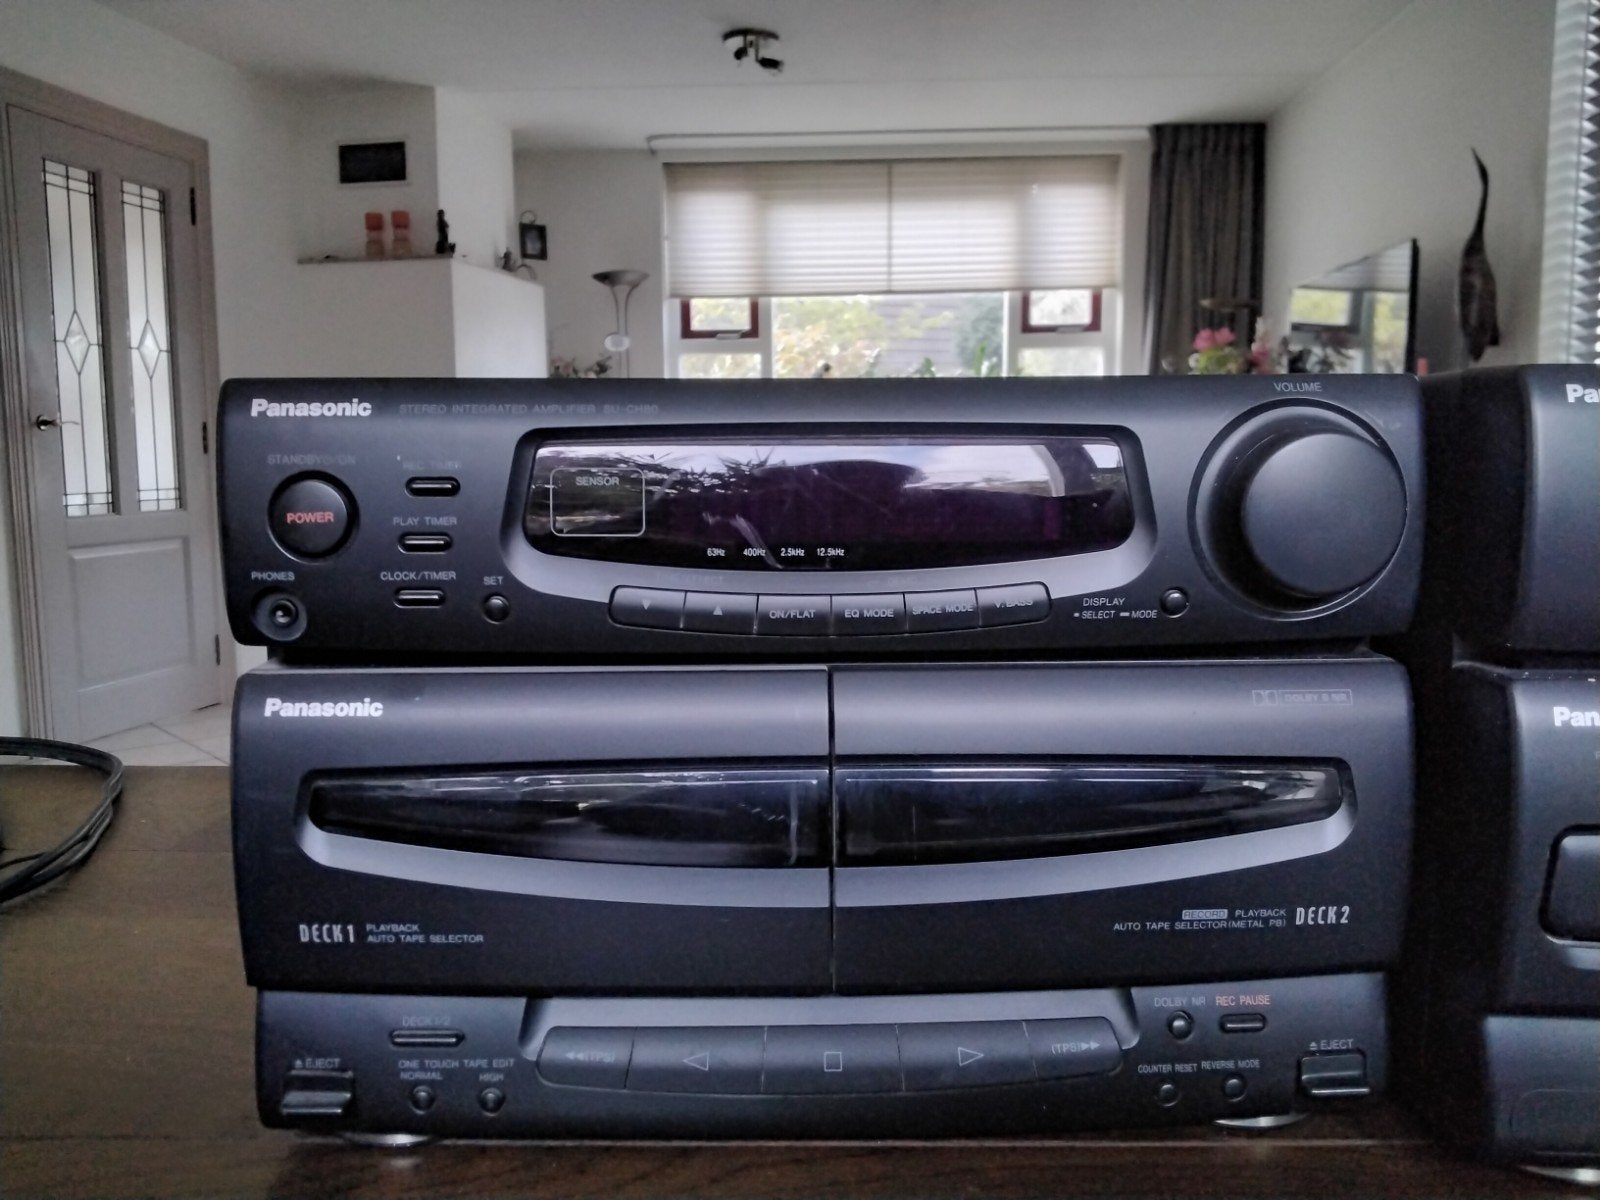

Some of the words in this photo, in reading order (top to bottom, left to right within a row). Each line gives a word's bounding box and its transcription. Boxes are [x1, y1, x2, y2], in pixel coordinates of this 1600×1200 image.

[1273, 381, 1322, 392] VOLUME
[1565, 383, 1600, 403] Pa
[250, 397, 372, 418] Panasonic
[398, 404, 446, 414] STEREO
[452, 403, 527, 414] INTEGRATED
[575, 475, 620, 487] SENSOR
[286, 511, 334, 525] POWER
[393, 516, 419, 527] PLAY
[425, 515, 458, 527] TIMER
[706, 547, 726, 558] 63Hz
[742, 547, 767, 558] 400Hz
[780, 547, 805, 558] 2.5kHz
[816, 547, 845, 558] 12.5kHz
[251, 570, 295, 582] PHONES
[380, 570, 457, 582] CLOCK/TIMER
[483, 574, 504, 586] SET
[1082, 597, 1126, 607] DISPLAY
[844, 608, 860, 619] EQ
[863, 608, 894, 618] MODE
[945, 602, 974, 614] MODE
[769, 608, 816, 620] ON/FLAT
[1081, 610, 1115, 620] SELECT
[1131, 609, 1158, 619] MODE
[263, 697, 384, 718] Panasonic
[1183, 908, 1229, 920] RECORD
[1235, 908, 1287, 918] PLAYBACK
[366, 924, 420, 933] PLAYBACK
[1113, 921, 1140, 931] AUTO
[1146, 920, 1170, 931] TAPE
[367, 934, 395, 943] AUTO
[399, 934, 426, 943] TAPE
[429, 934, 484, 943] SELECTOR
[1154, 997, 1187, 1008] DOLBY
[1215, 996, 1236, 1007] REC
[1239, 995, 1271, 1006] PAUSE
[1320, 1039, 1354, 1051] EJECT
[305, 1058, 341, 1070] EJECT
[398, 1059, 420, 1069] ONE
[424, 1059, 460, 1070] TOUCH
[464, 1059, 490, 1070] TAPE
[493, 1059, 515, 1070] EDIT
[1137, 1064, 1173, 1074] COUNTER
[1175, 1063, 1199, 1073] RESET
[1201, 1060, 1236, 1070] REVERSE
[1238, 1059, 1261, 1069] MODE
[400, 1071, 445, 1082] NORMAL
[479, 1073, 505, 1083] HIGH
